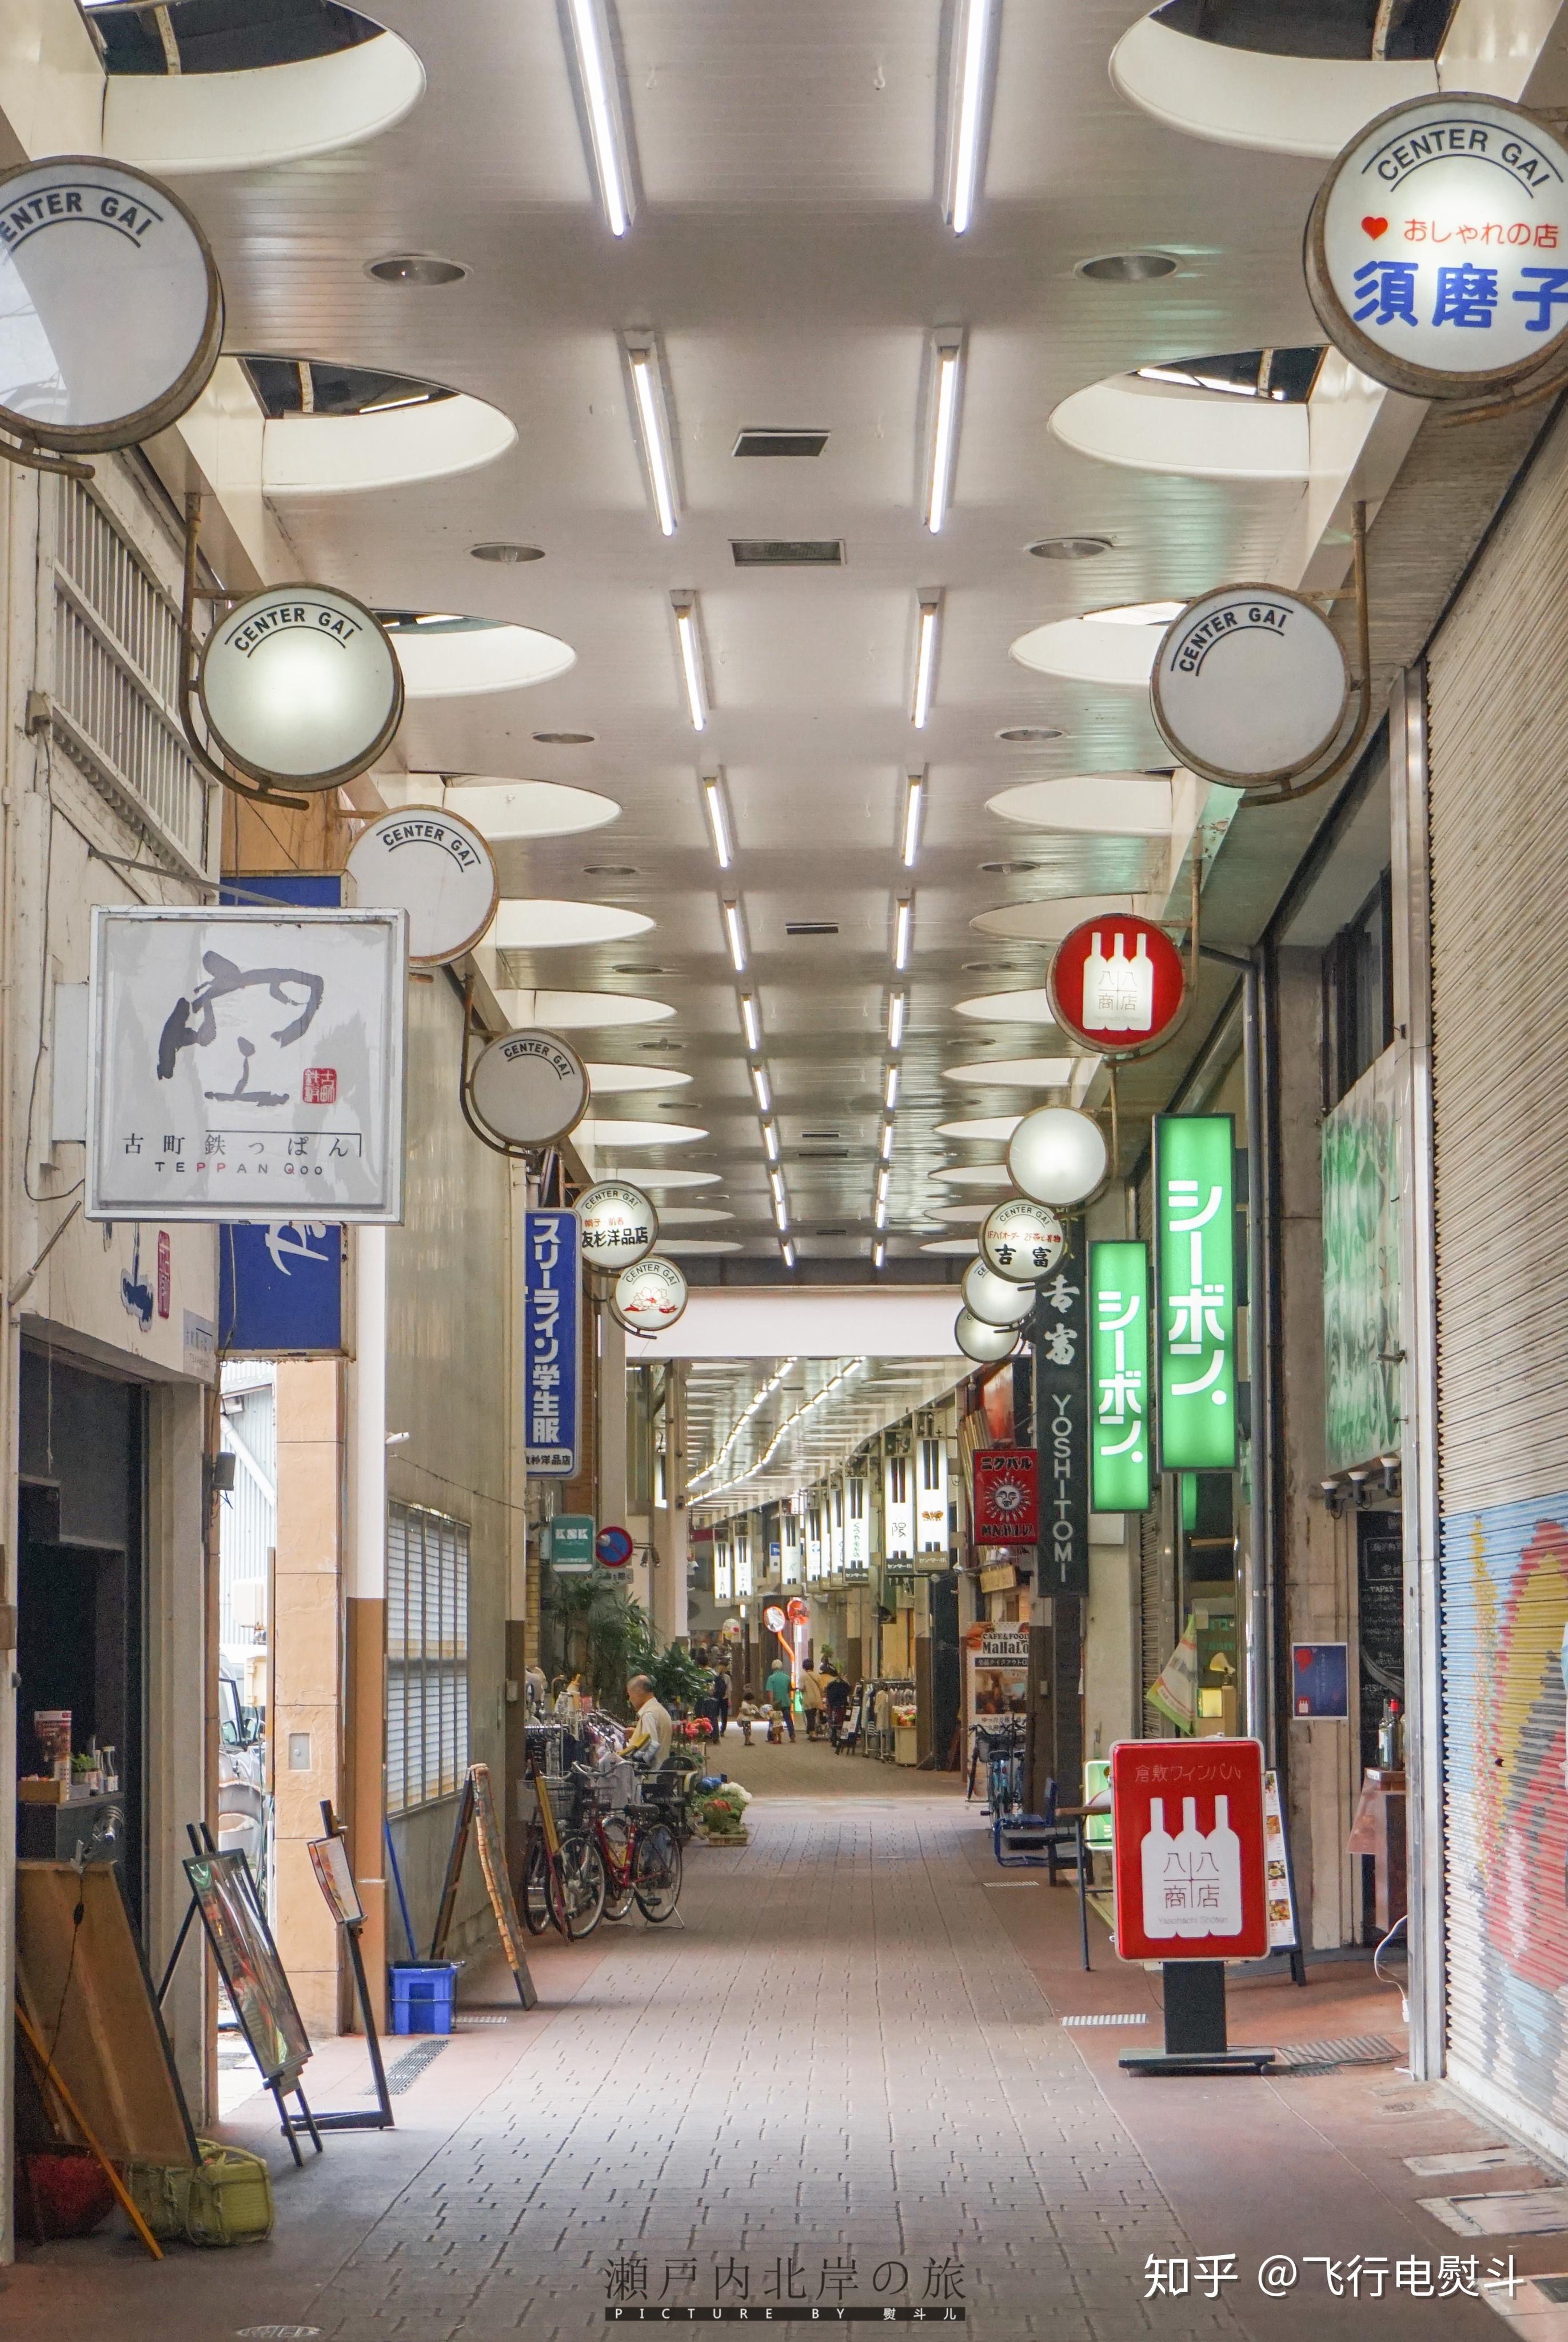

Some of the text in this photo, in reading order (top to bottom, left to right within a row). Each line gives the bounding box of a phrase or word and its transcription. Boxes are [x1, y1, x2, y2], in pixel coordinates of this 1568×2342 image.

[1377, 128, 1551, 188] CENTER GAI
[101, 196, 153, 236] GAI
[1403, 218, 1559, 249] おしゃれの店
[1353, 260, 1568, 332] 須磨子
[234, 607, 355, 652] CENTER GAI
[1178, 607, 1288, 672] CENTER GAI
[382, 824, 476, 867] CENTER GAI
[503, 1042, 572, 1077] CENTER GAI
[122, 1133, 349, 1157] 古町鉄っぱん
[154, 1162, 323, 1176] TEPPAN Qoo
[585, 1190, 639, 1210] CENTER GAI
[999, 1206, 1051, 1225] CENTER GAI
[582, 1225, 649, 1248] 友杉洋品店
[625, 1264, 678, 1286] CENTER GAI
[532, 1217, 560, 1444] スリーライン学生服
[1051, 1393, 1074, 1583] YOSHITOMI
[1135, 1763, 1241, 1783] 倉敷ワインバル
[1163, 1851, 1220, 1873] 八八
[1163, 1884, 1220, 1909] 商店
